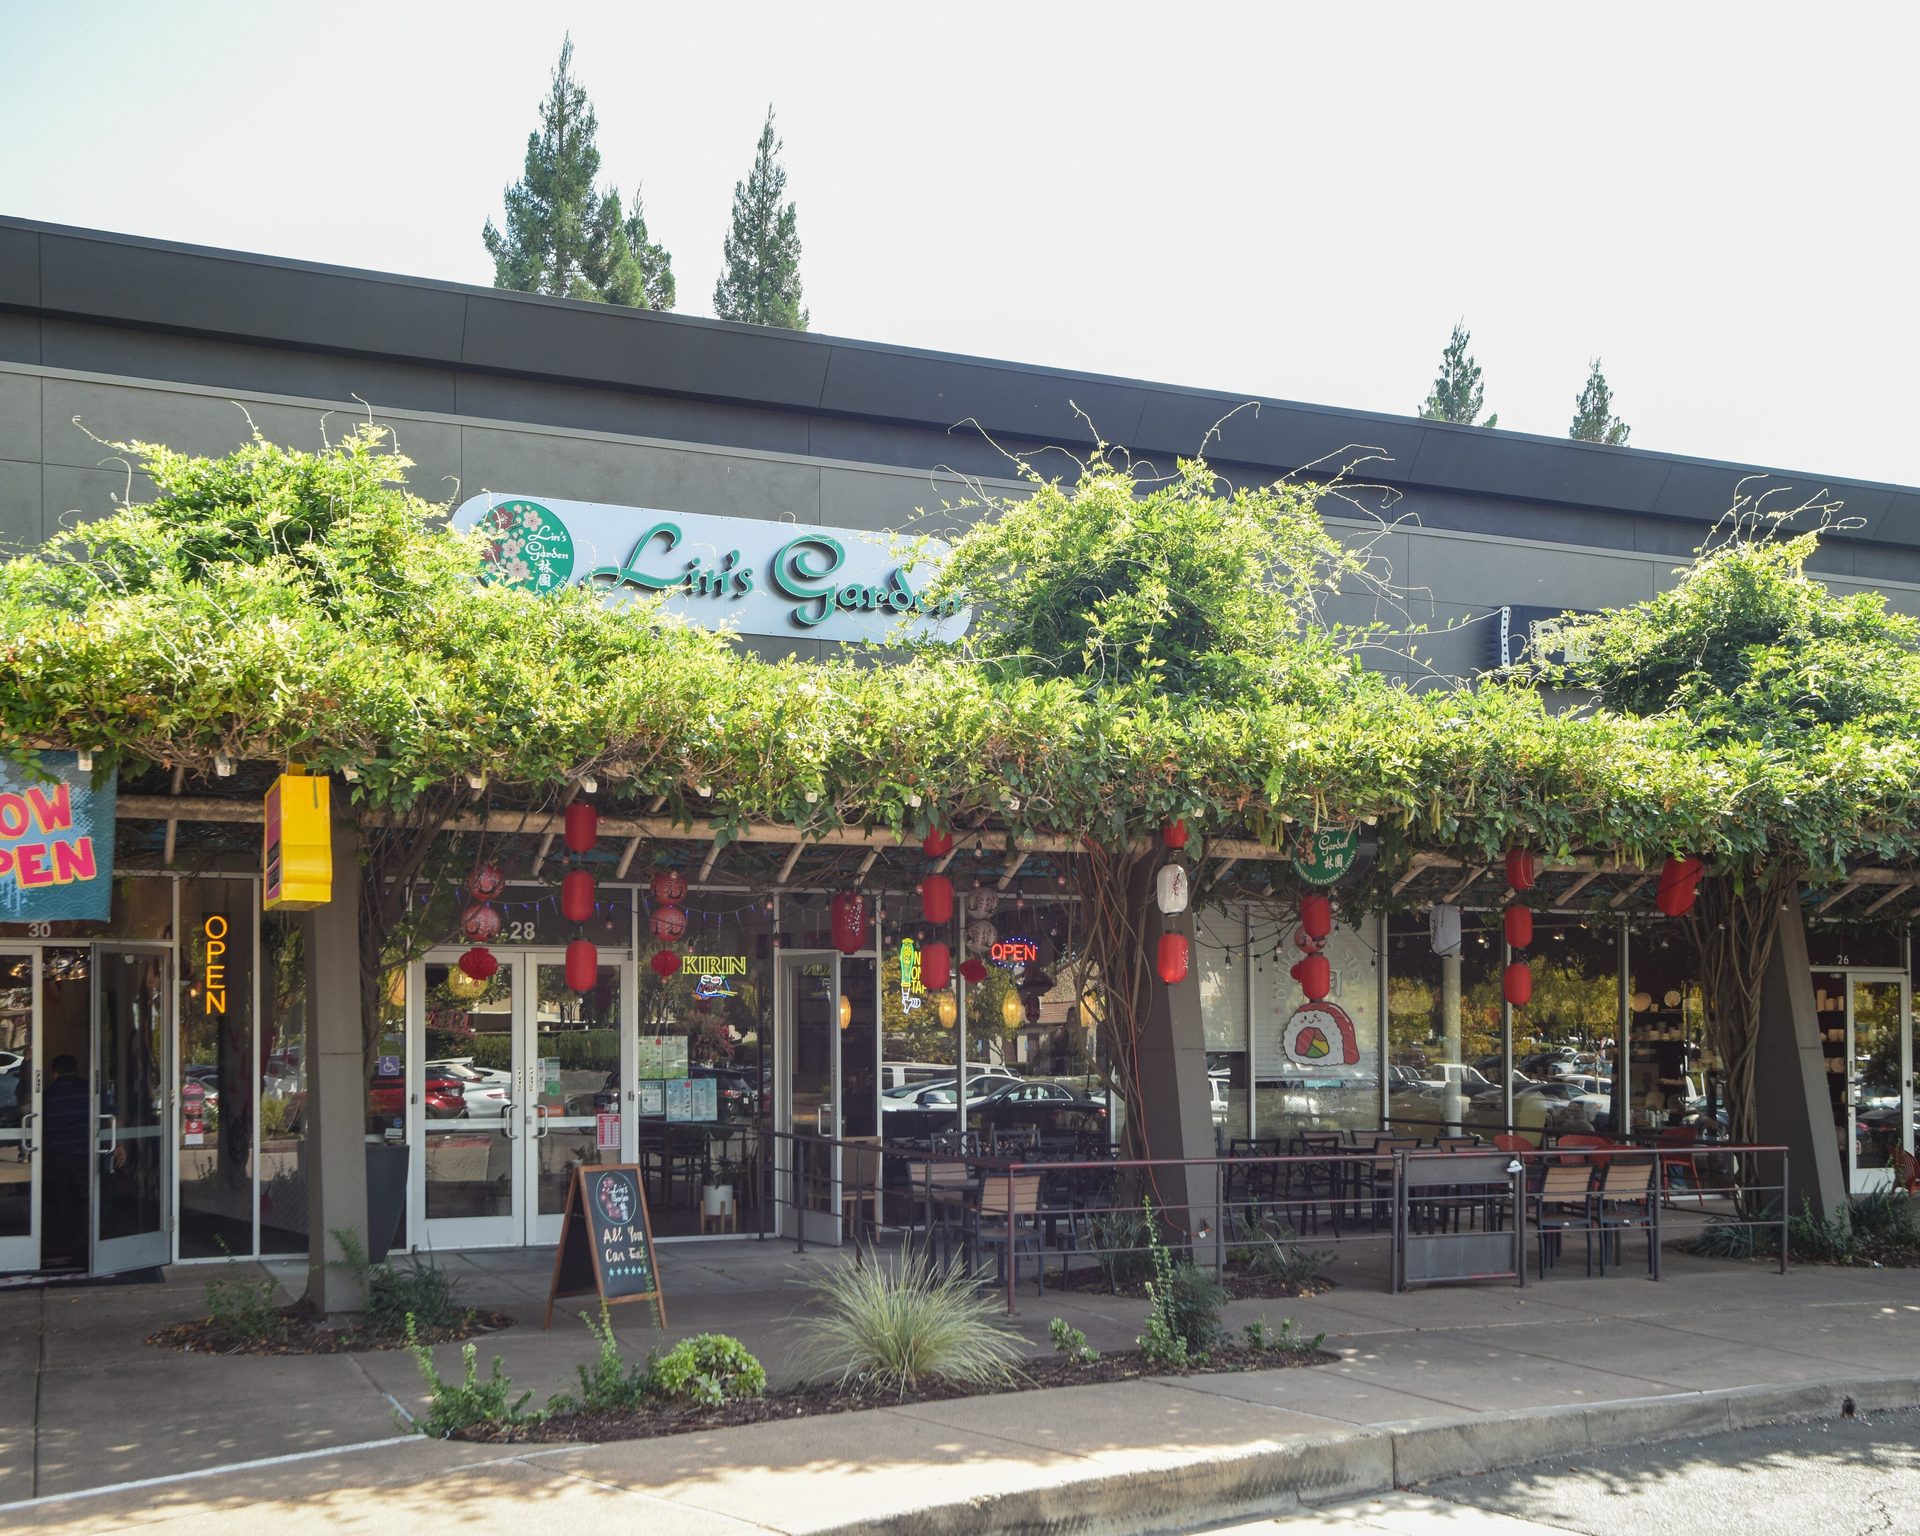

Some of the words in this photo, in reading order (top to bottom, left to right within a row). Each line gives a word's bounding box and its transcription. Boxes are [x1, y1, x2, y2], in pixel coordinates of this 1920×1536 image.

[527, 525, 567, 542] Lin's
[525, 541, 569, 561] Garden
[583, 521, 754, 597] Lin's
[1319, 835, 1349, 856] Garden
[28, 924, 51, 938] 30
[510, 921, 536, 940] 28
[991, 943, 1037, 961] OPEN
[1837, 954, 1849, 965] 26
[205, 915, 228, 1015] OPEN
[682, 955, 746, 976] KIRIN
[603, 1226, 623, 1244] All
[627, 1225, 643, 1243] You
[605, 1248, 625, 1263] Can
[628, 1246, 645, 1260] Eat
